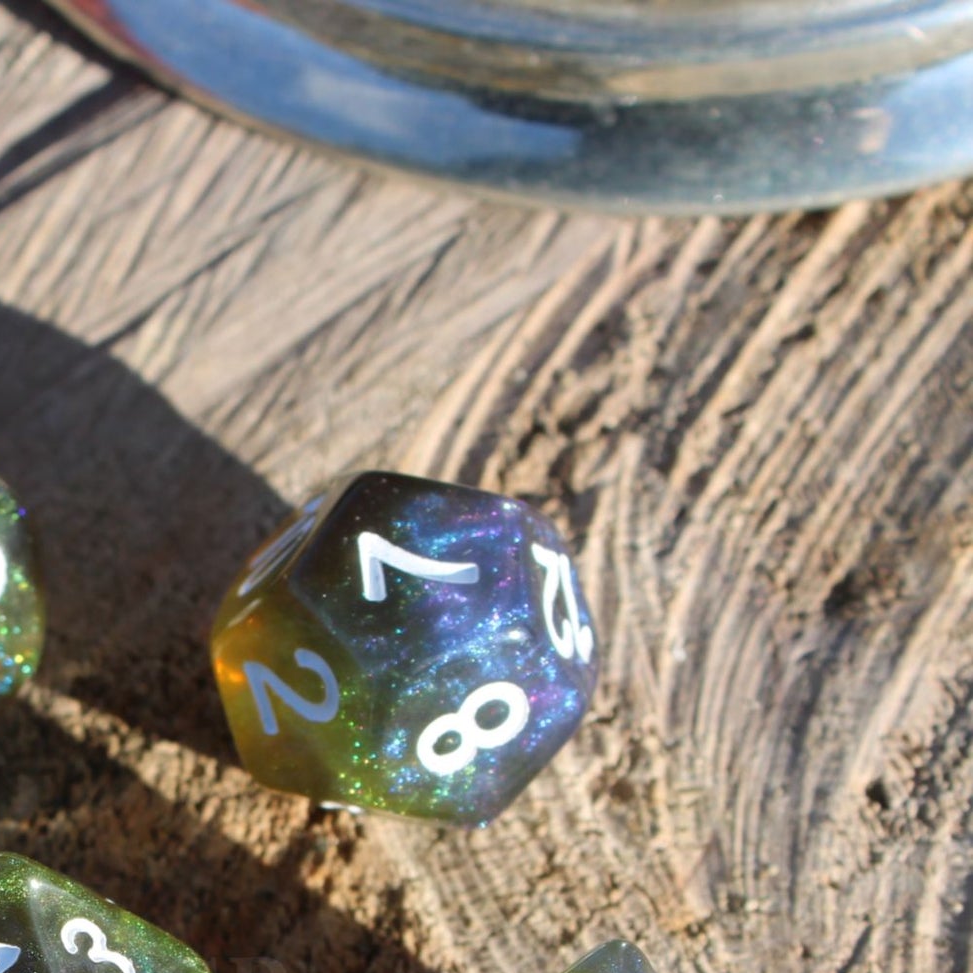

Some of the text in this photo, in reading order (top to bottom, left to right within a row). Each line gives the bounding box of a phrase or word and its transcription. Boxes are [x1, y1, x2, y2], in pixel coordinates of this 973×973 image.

[357, 531, 479, 602] 7
[242, 647, 339, 736] 2
[416, 681, 531, 777] 8
